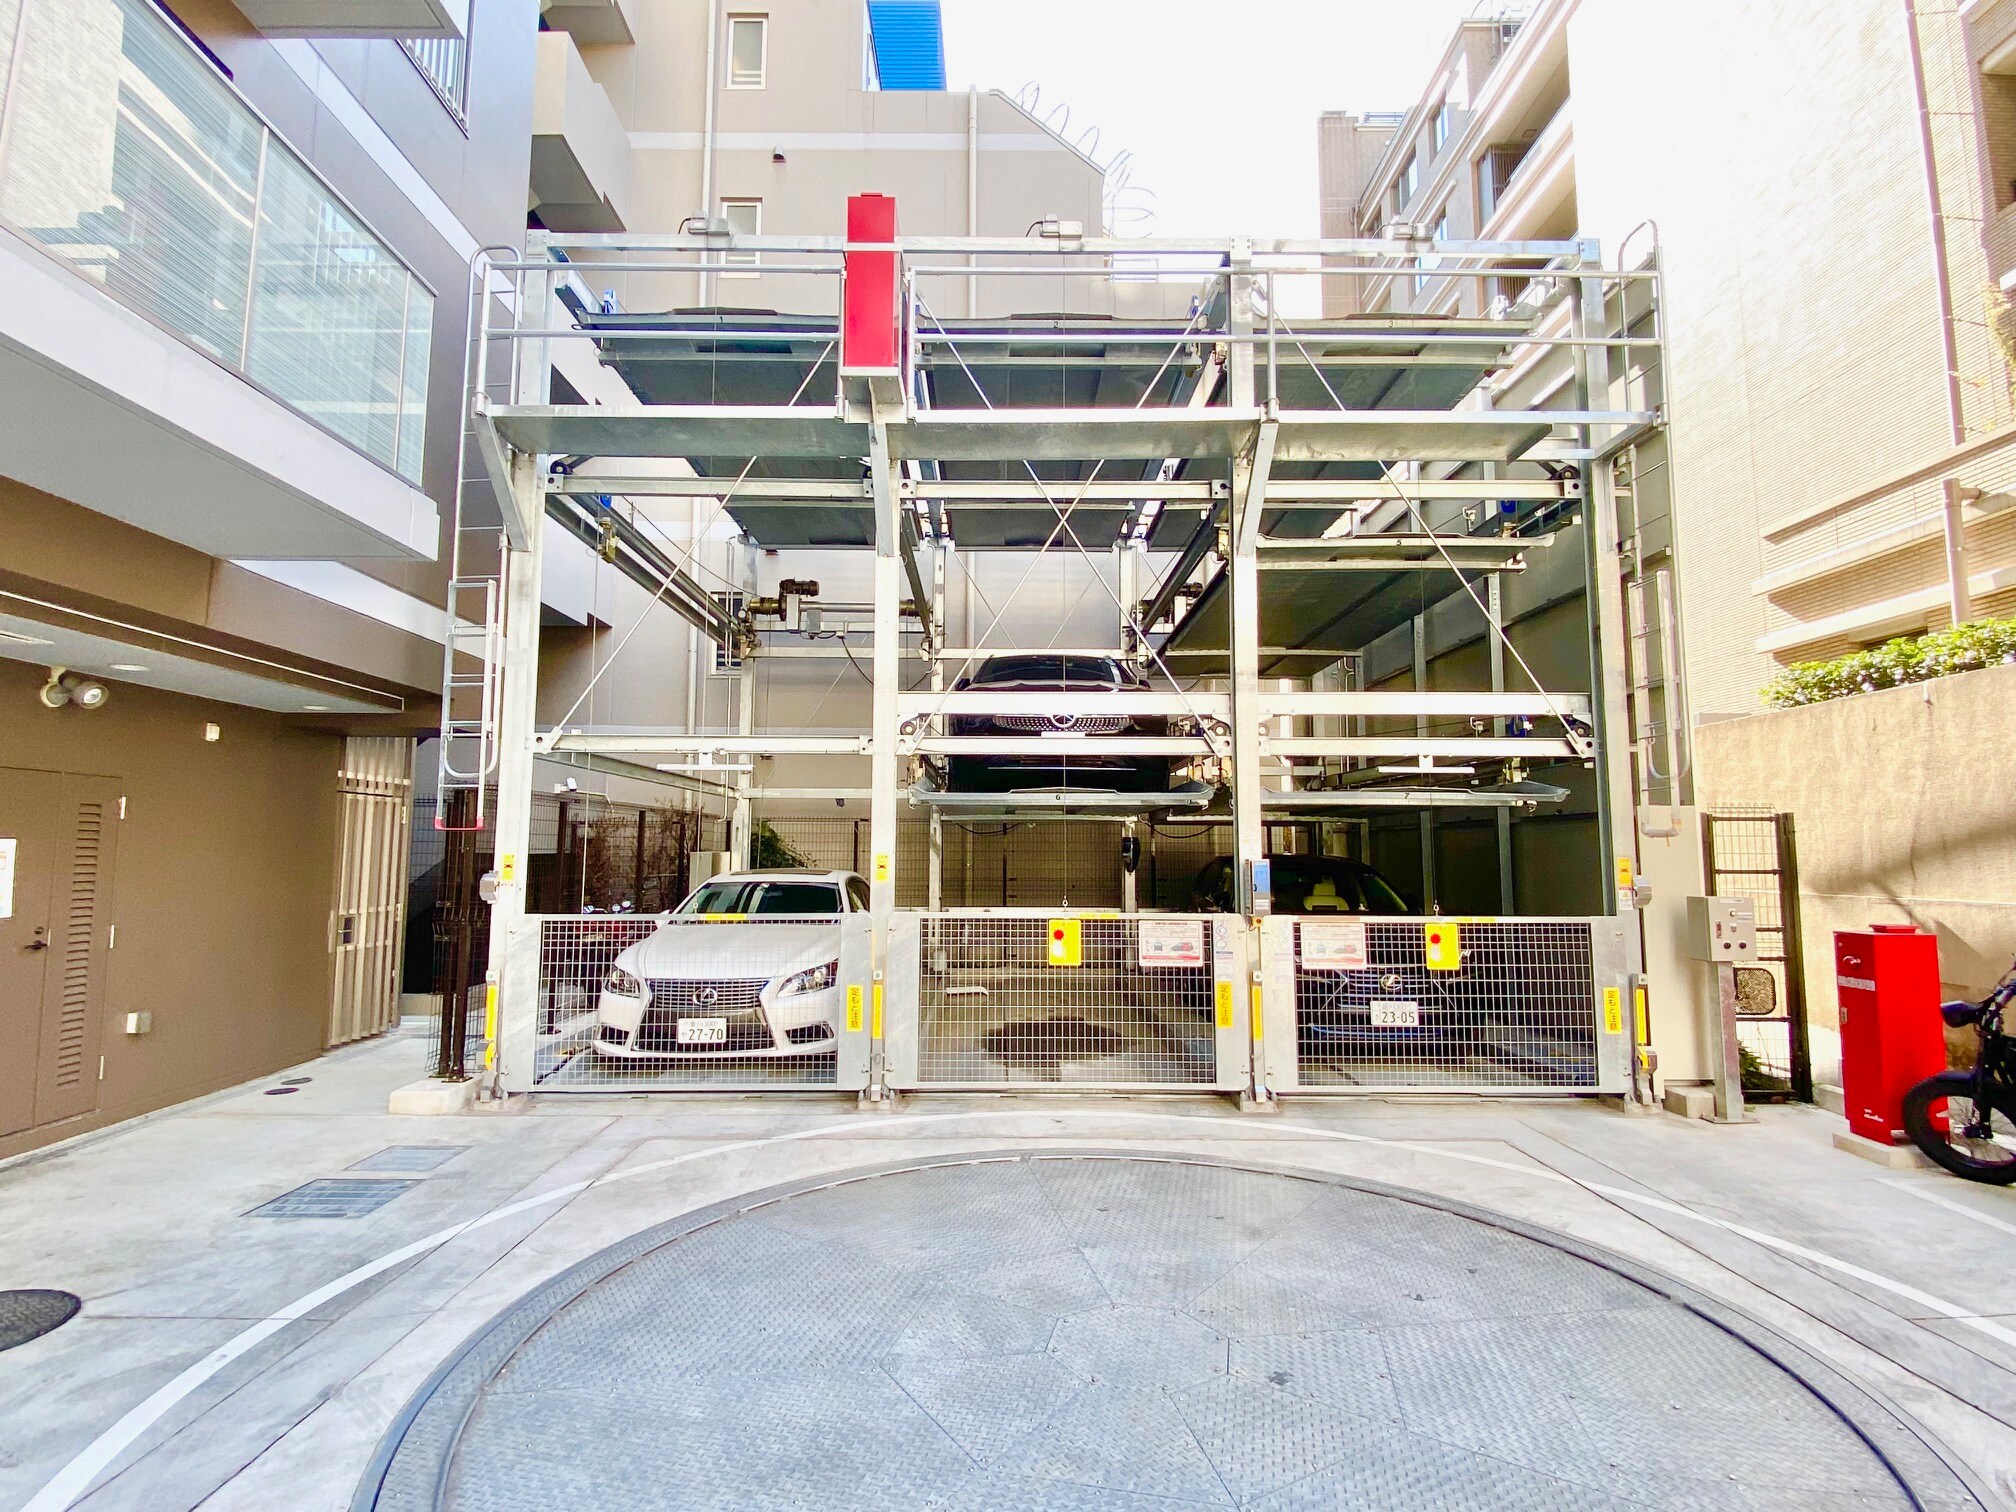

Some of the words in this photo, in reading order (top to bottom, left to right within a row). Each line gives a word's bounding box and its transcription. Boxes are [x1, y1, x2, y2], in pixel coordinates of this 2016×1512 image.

[1053, 321, 1059, 329] 2
[1388, 320, 1394, 328] 3
[1396, 539, 1402, 547] 5
[850, 987, 859, 1029] 足もと注意
[1607, 990, 1618, 1031] 足もと注意
[1381, 1011, 1415, 1024] 23-05
[688, 1028, 724, 1041] 27-70
